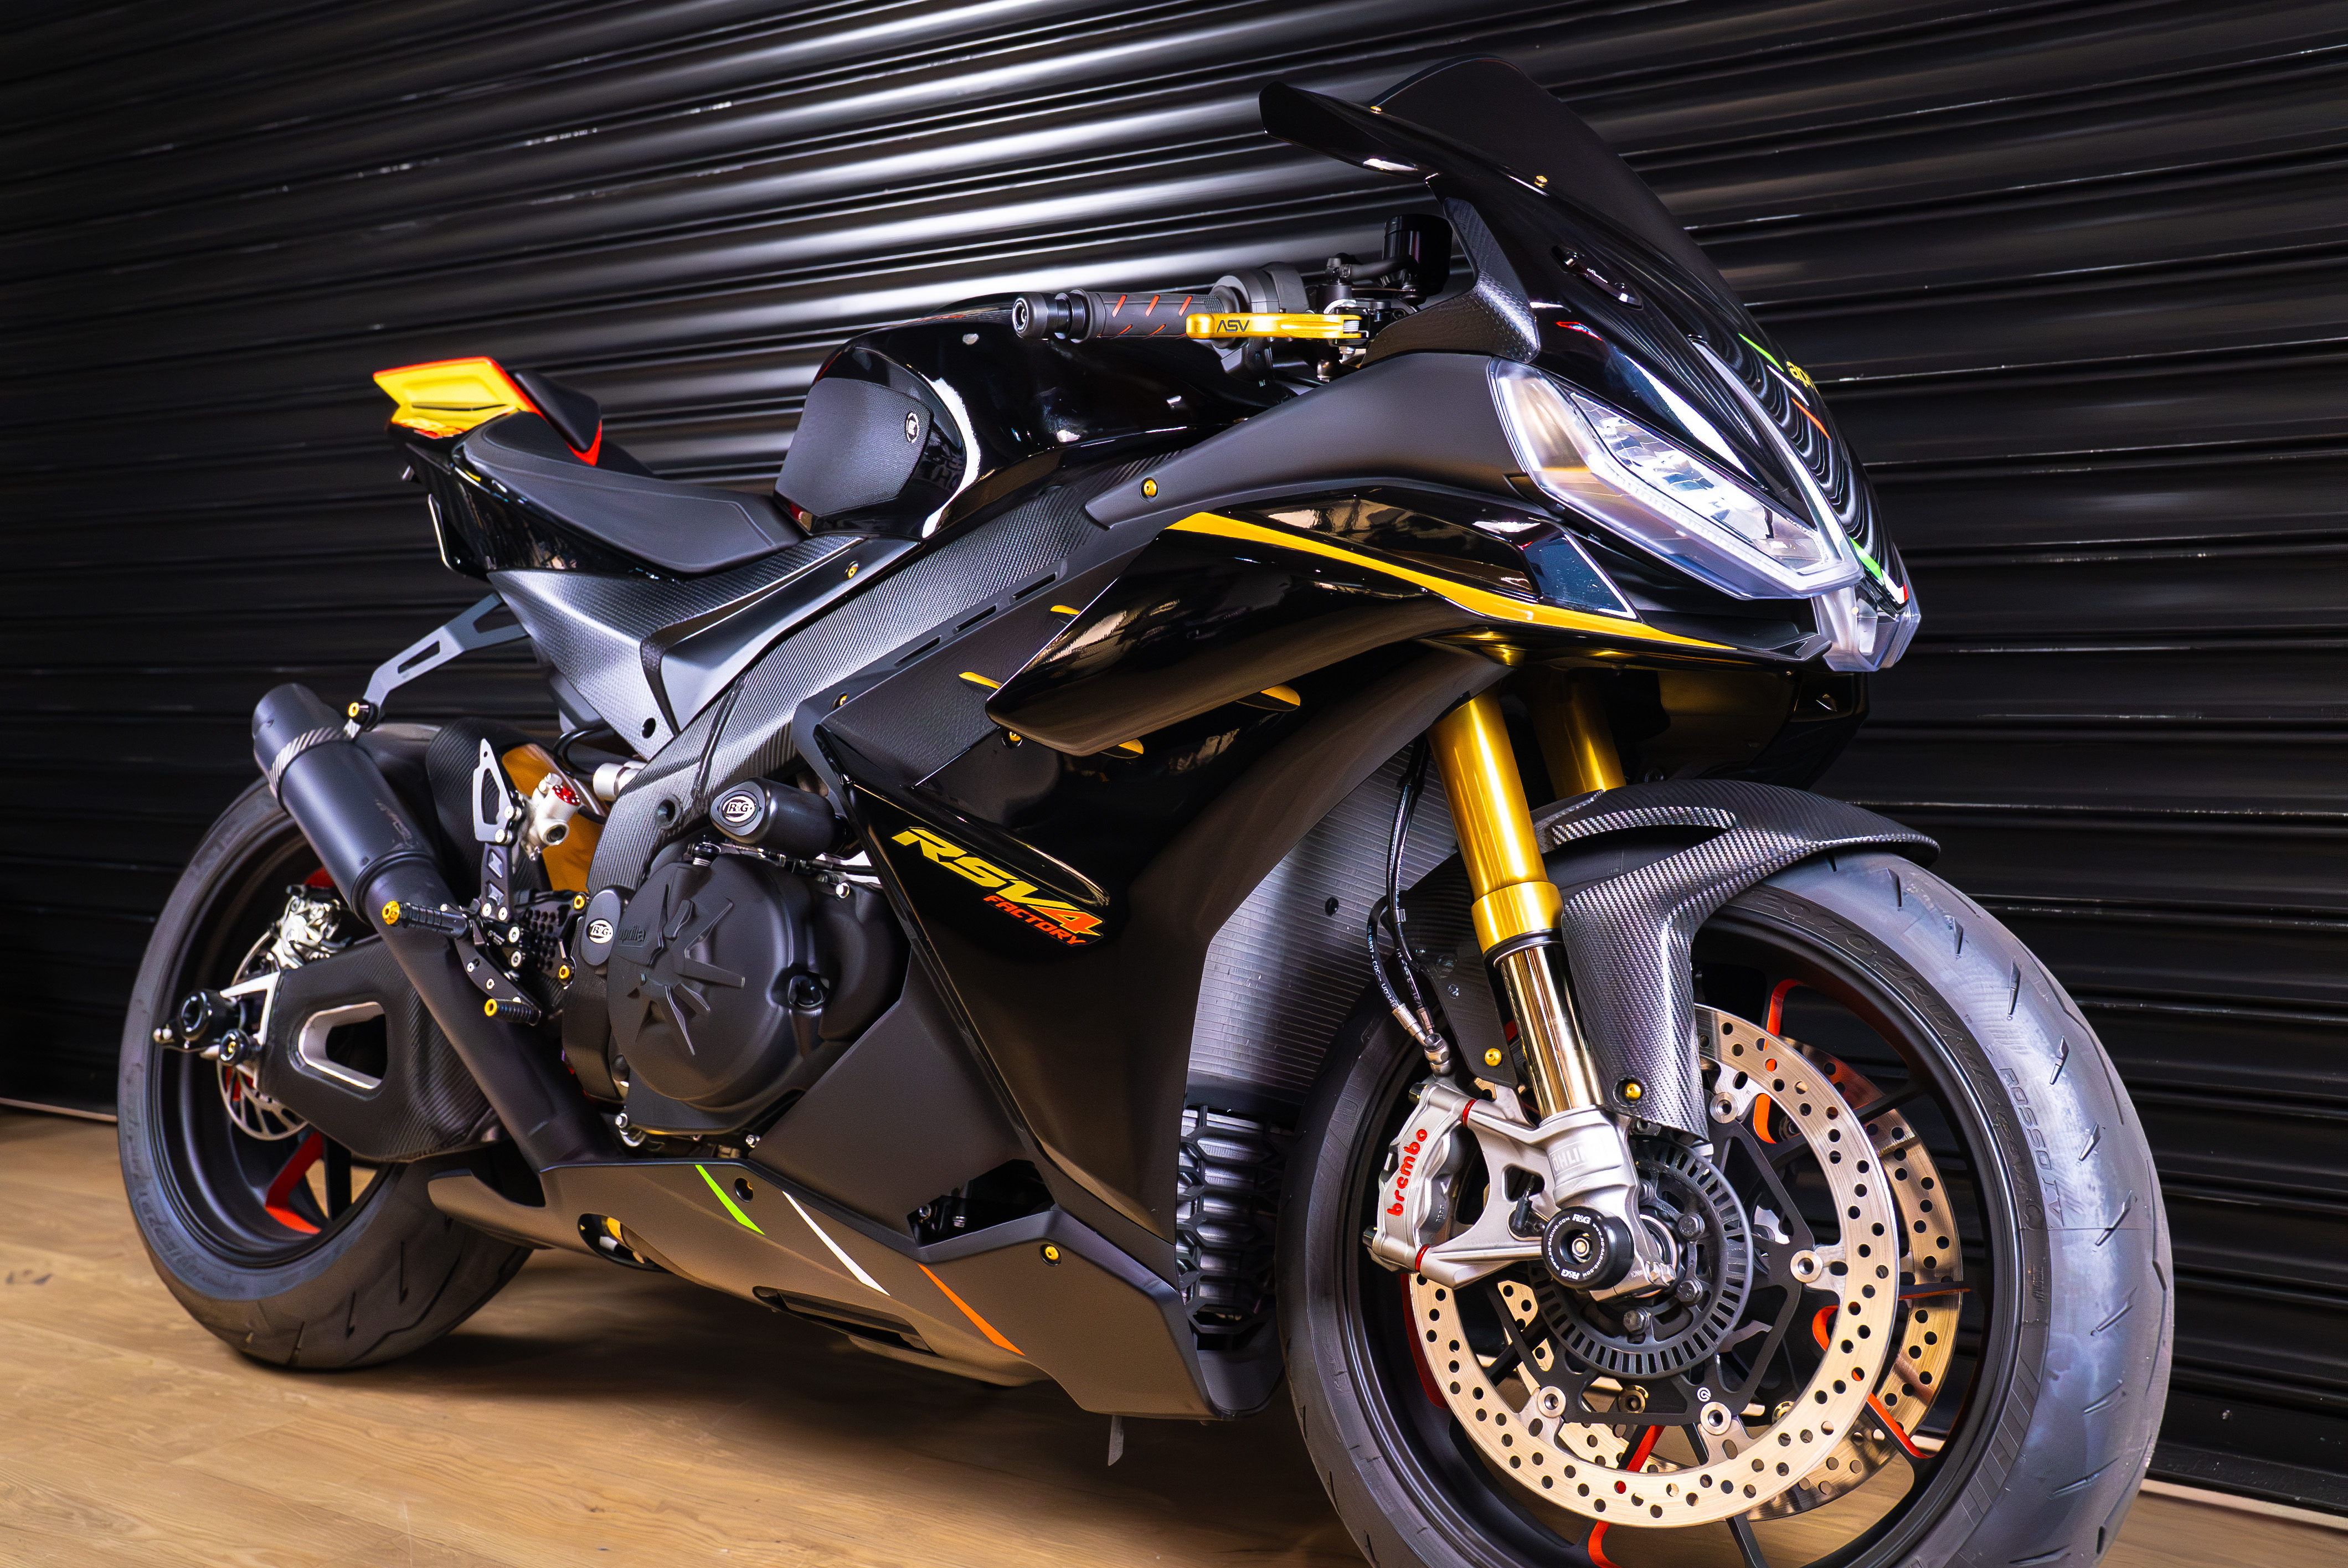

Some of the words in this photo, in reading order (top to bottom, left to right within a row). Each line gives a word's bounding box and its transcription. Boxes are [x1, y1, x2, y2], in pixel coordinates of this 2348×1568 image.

[1217, 319, 1250, 333] ASV
[891, 827, 1104, 936] RSV4
[983, 895, 1087, 945] FACTORY
[1998, 1067, 2052, 1170] ROSSO
[1386, 1128, 1428, 1216] brembo
[1572, 1213, 1592, 1225] R&G
[1560, 1268, 1580, 1280] R&G
